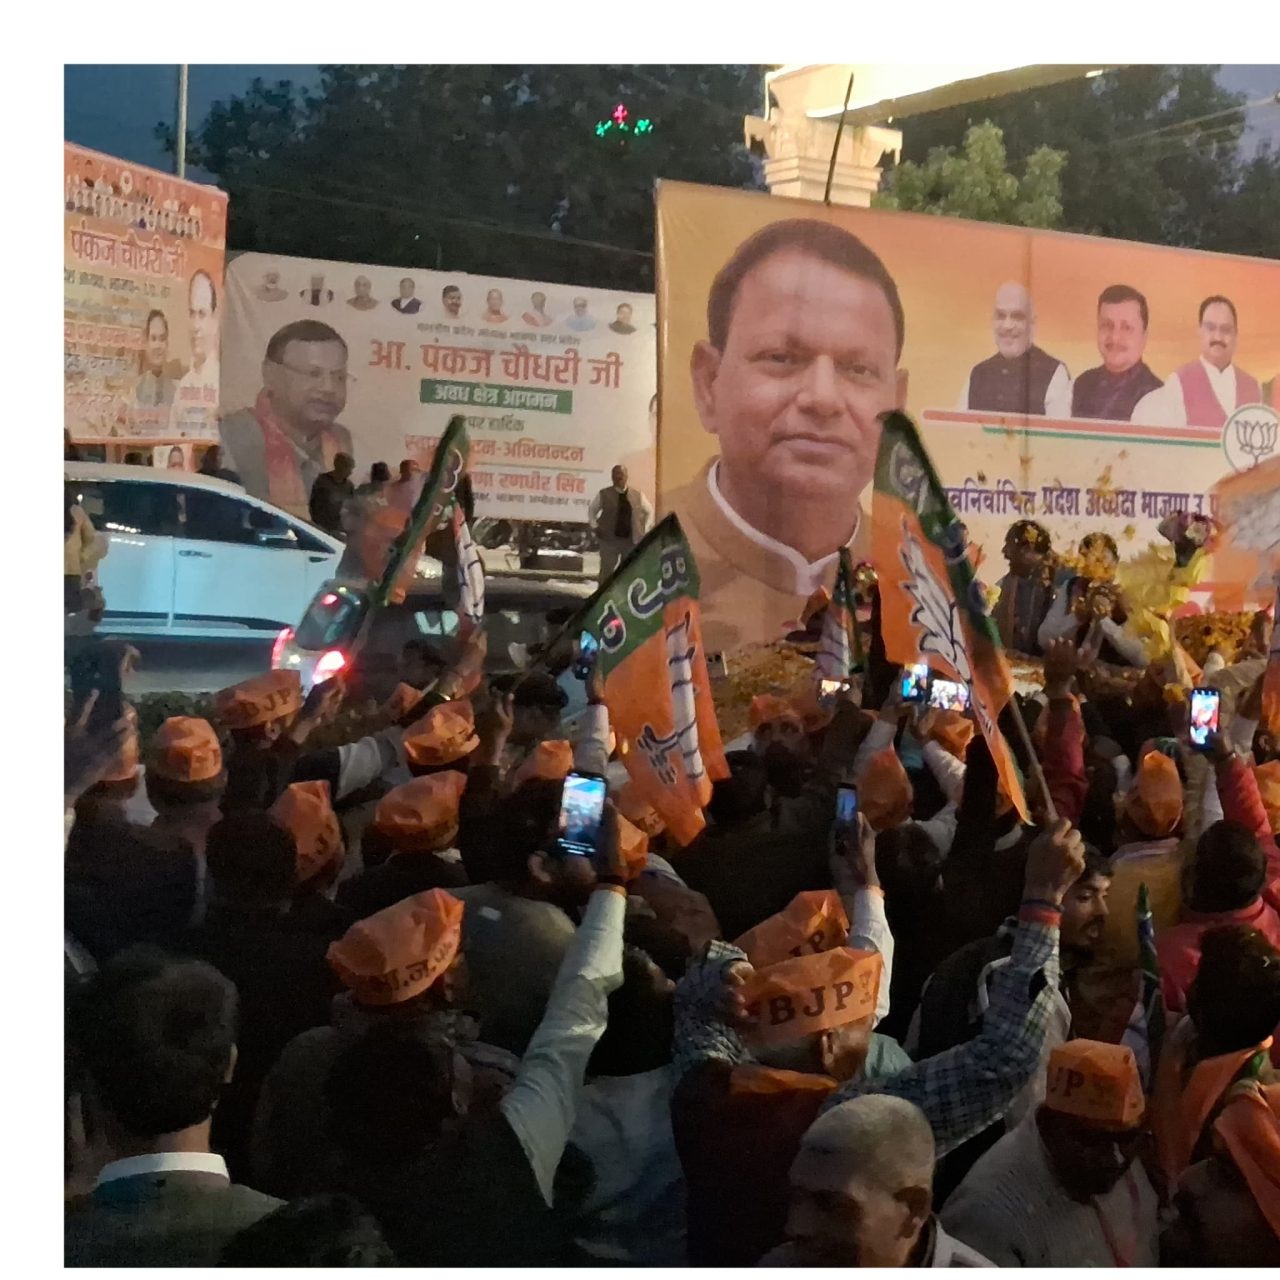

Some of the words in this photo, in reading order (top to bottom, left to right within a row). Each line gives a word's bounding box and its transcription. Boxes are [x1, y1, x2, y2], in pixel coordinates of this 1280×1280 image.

[70, 218, 116, 266] पंकज
[121, 229, 163, 274] चौधरी
[368, 338, 411, 370] आ.
[419, 337, 495, 378] पंकज
[500, 343, 582, 385] चौधरी
[588, 349, 624, 388] जी
[433, 384, 470, 400] अवध
[503, 389, 558, 410] आगमन
[499, 471, 552, 491] रणधीर
[556, 472, 586, 493] सिंह
[1042, 478, 1080, 515] प्रदेश
[769, 982, 859, 1027] BJP
